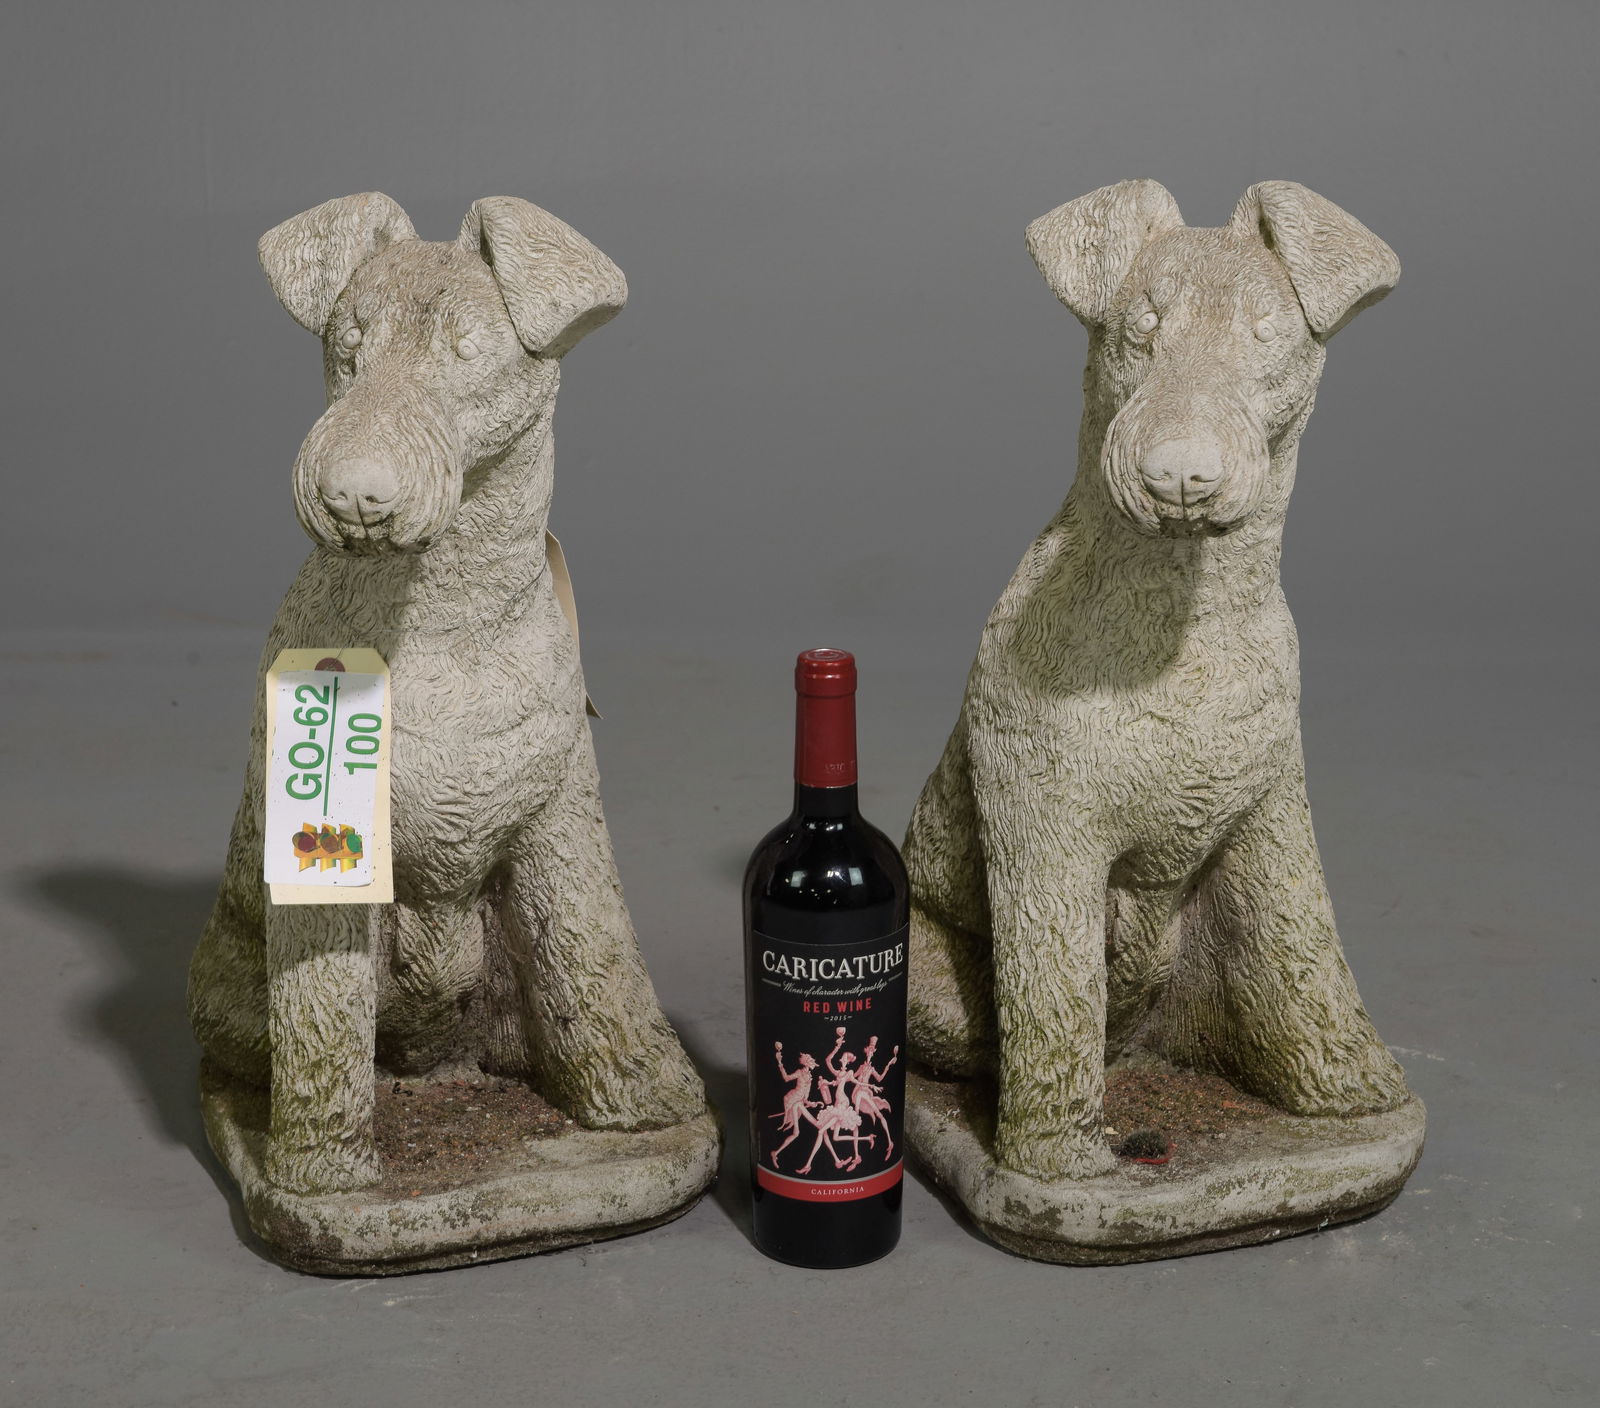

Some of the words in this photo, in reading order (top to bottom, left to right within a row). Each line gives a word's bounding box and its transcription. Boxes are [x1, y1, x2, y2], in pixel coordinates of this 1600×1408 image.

[285, 684, 330, 801] GO-62
[343, 713, 382, 775] 100
[762, 942, 904, 982] CARICATURE
[783, 980, 803, 994] Wines
[812, 986, 843, 995] character
[803, 1001, 830, 1014] RED
[837, 998, 872, 1013] WINE
[811, 1186, 865, 1196] CALIFORNIA
